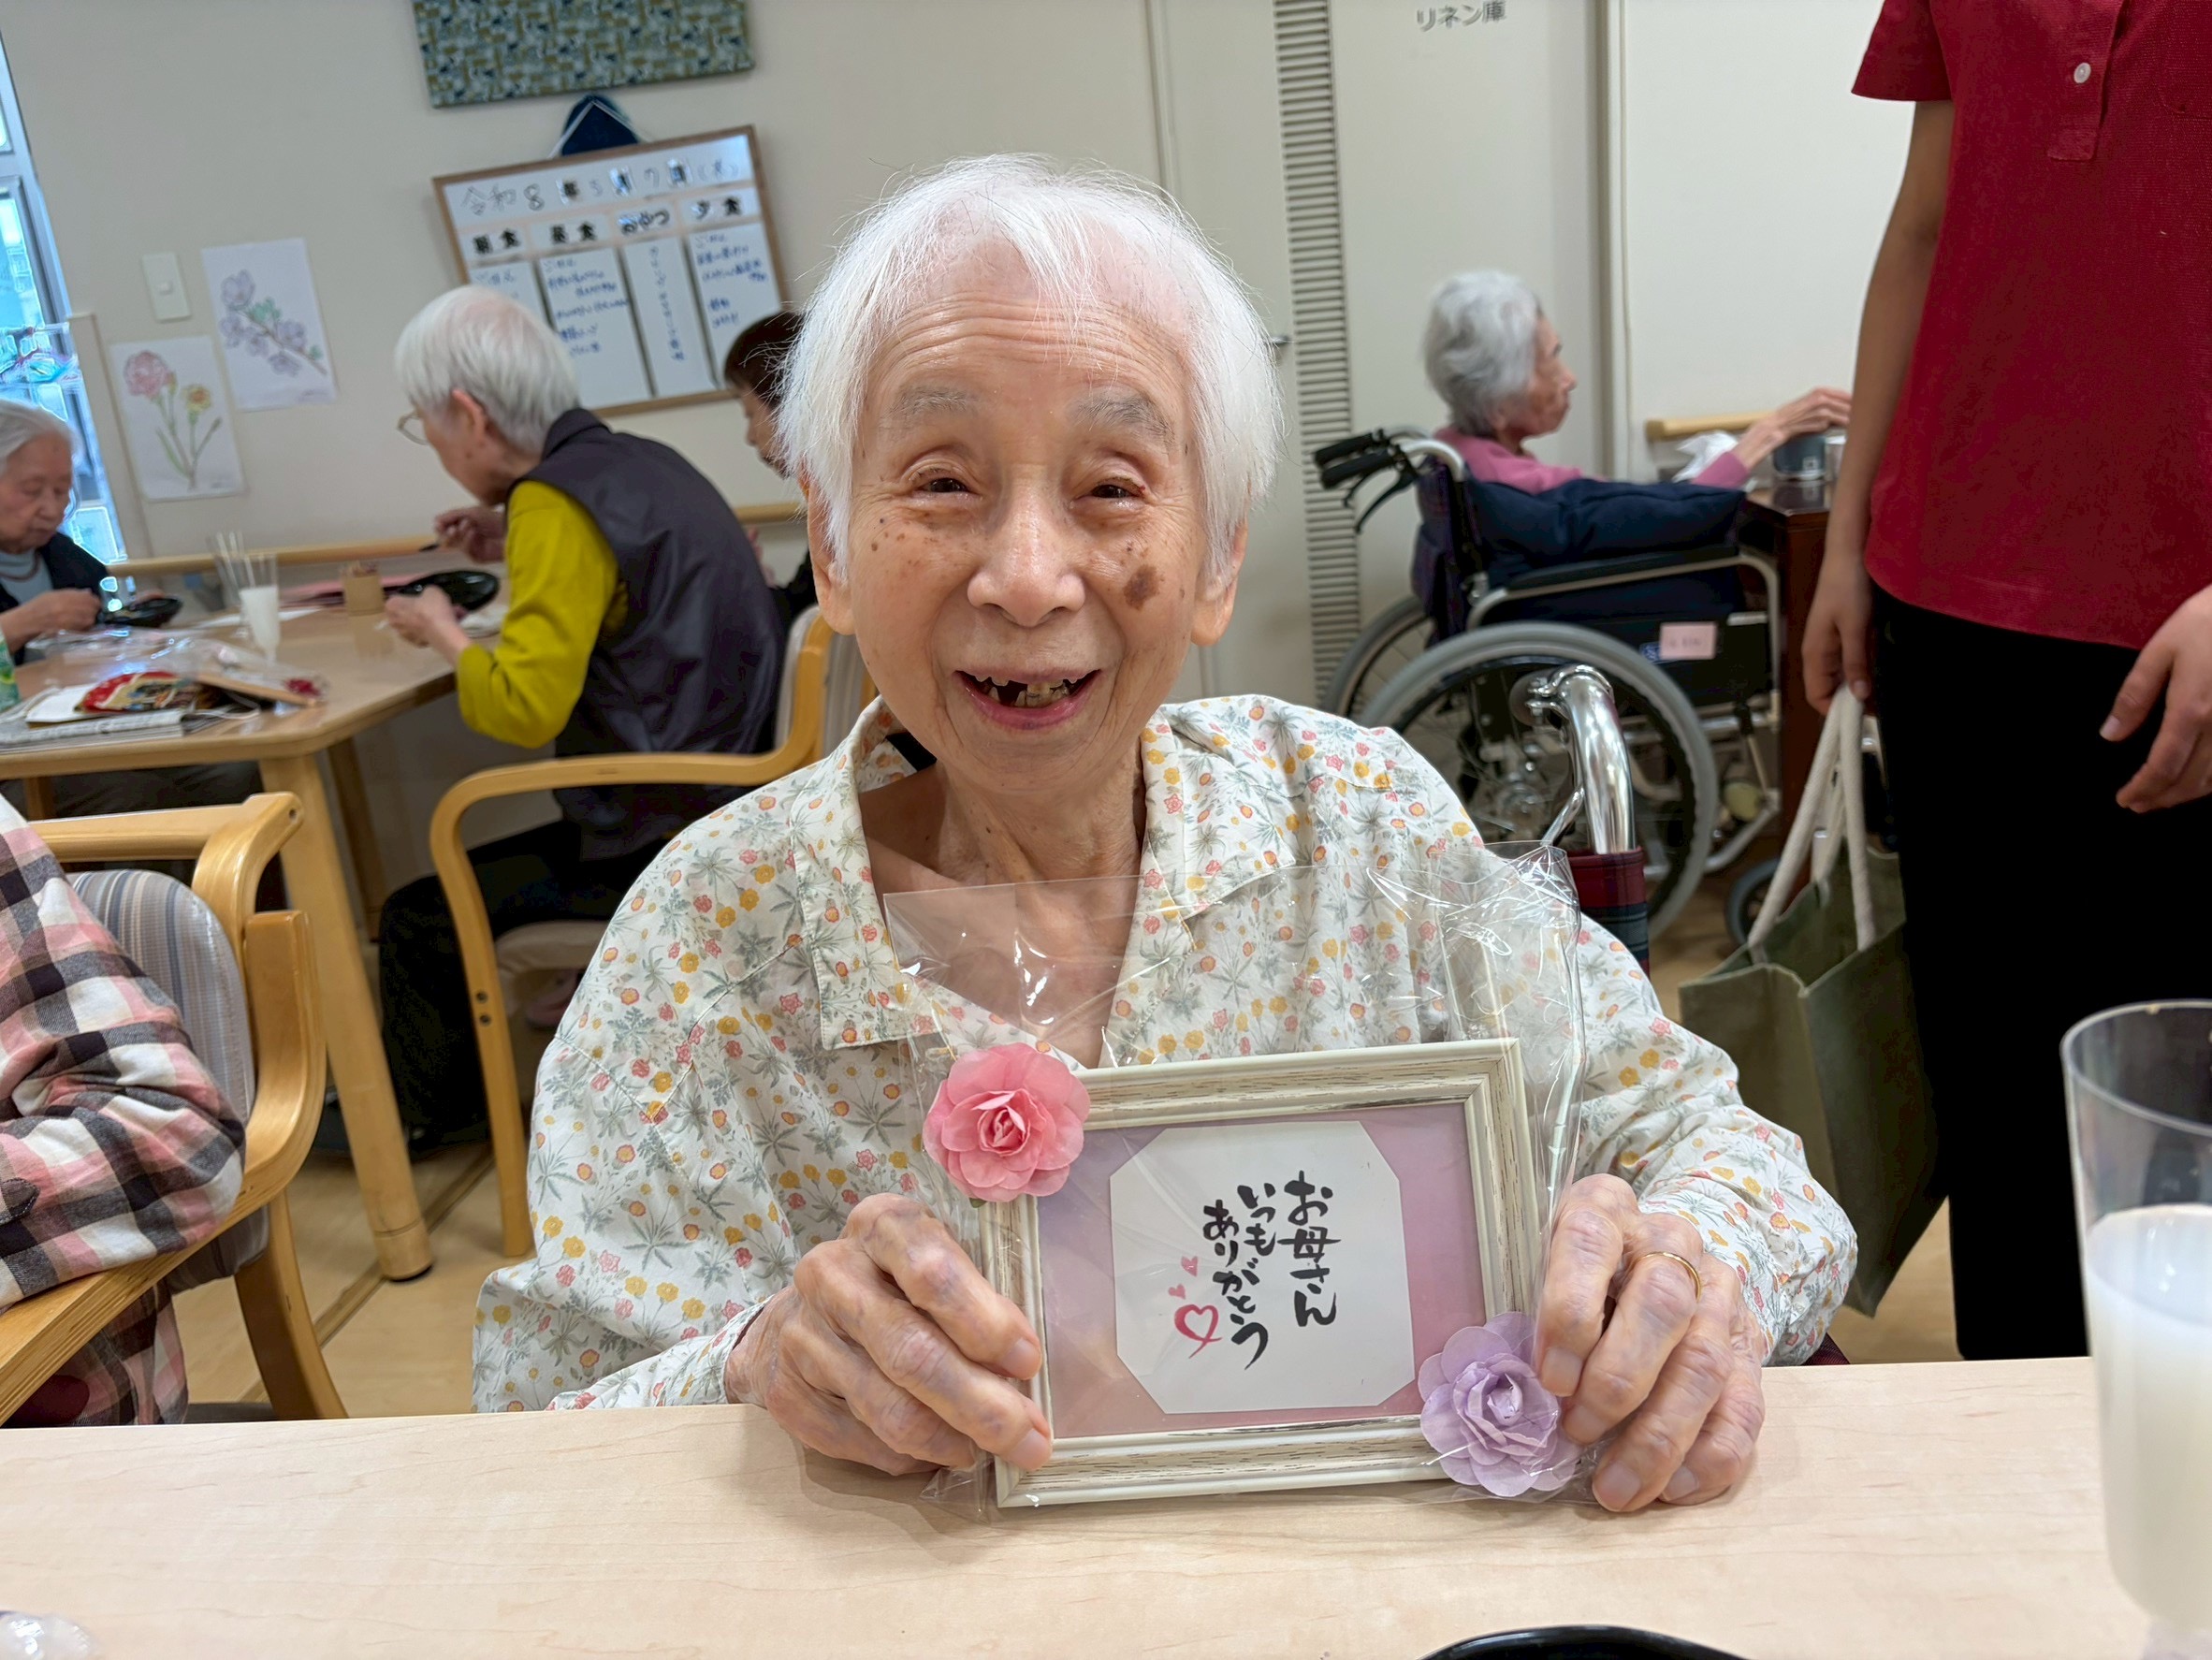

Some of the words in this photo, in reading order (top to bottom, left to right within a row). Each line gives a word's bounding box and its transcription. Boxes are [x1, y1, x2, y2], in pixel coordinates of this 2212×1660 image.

[1416, 0, 1506, 32] リネン庫
[1237, 1182, 1276, 1257] いつも
[1277, 1170, 1341, 1327] お母さん
[1202, 1199, 1269, 1370] ありがとう
